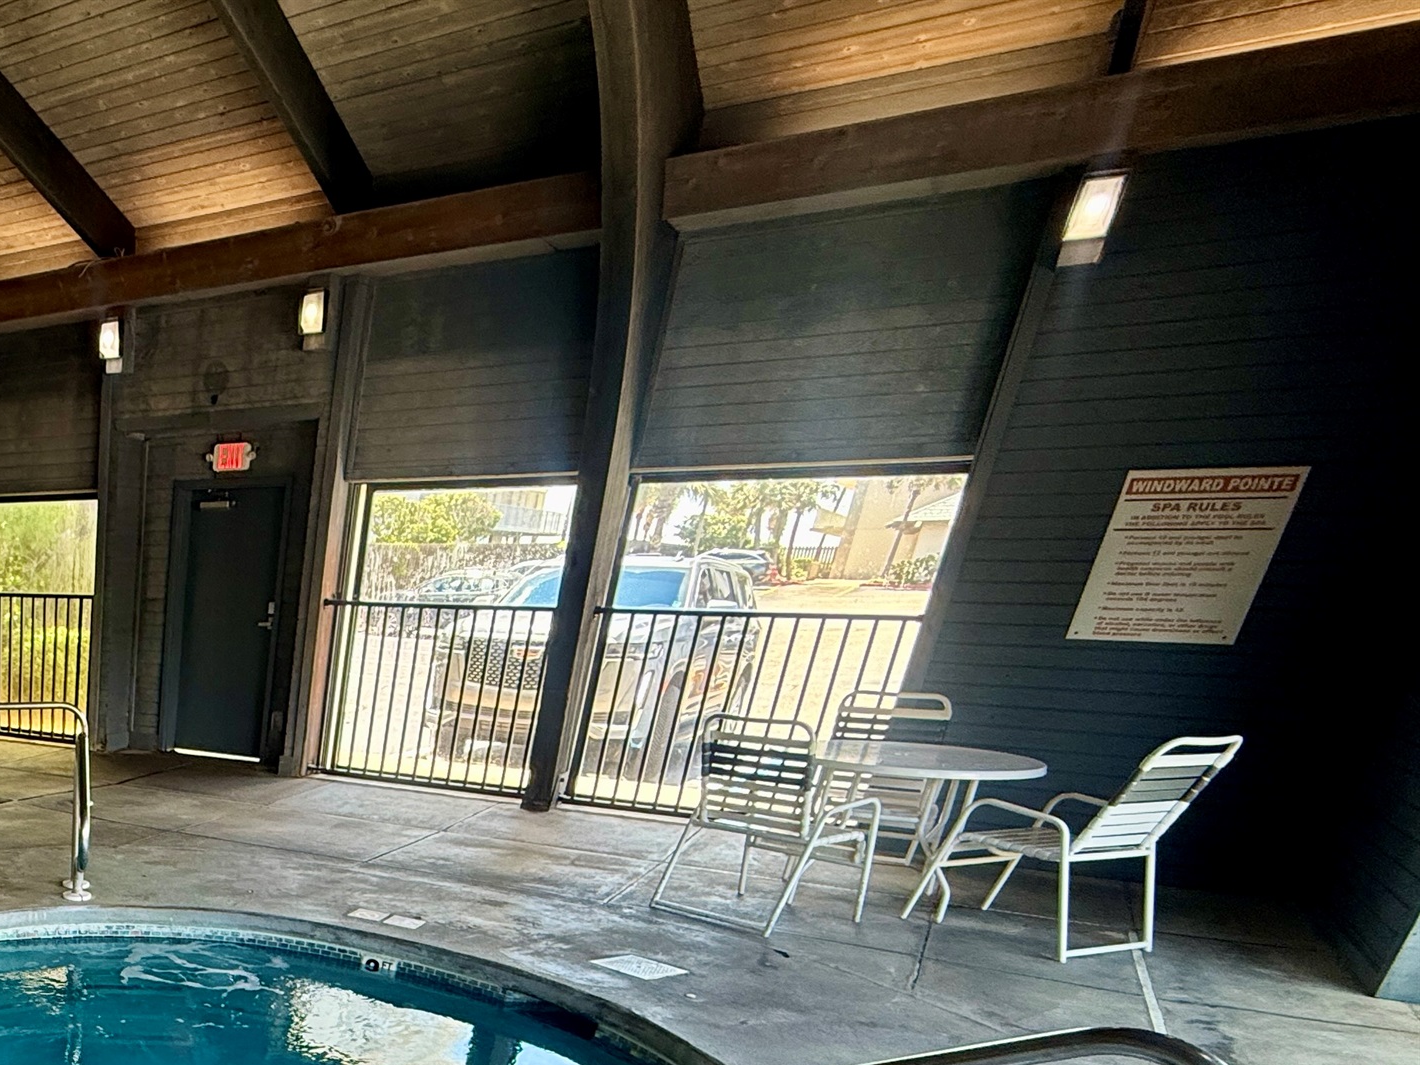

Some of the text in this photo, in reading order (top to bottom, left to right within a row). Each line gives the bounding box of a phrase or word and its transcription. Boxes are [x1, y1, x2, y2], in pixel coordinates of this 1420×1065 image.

[1132, 476, 1295, 493] WINDWARD POINTE
[1151, 501, 1244, 512] SPA RULES
